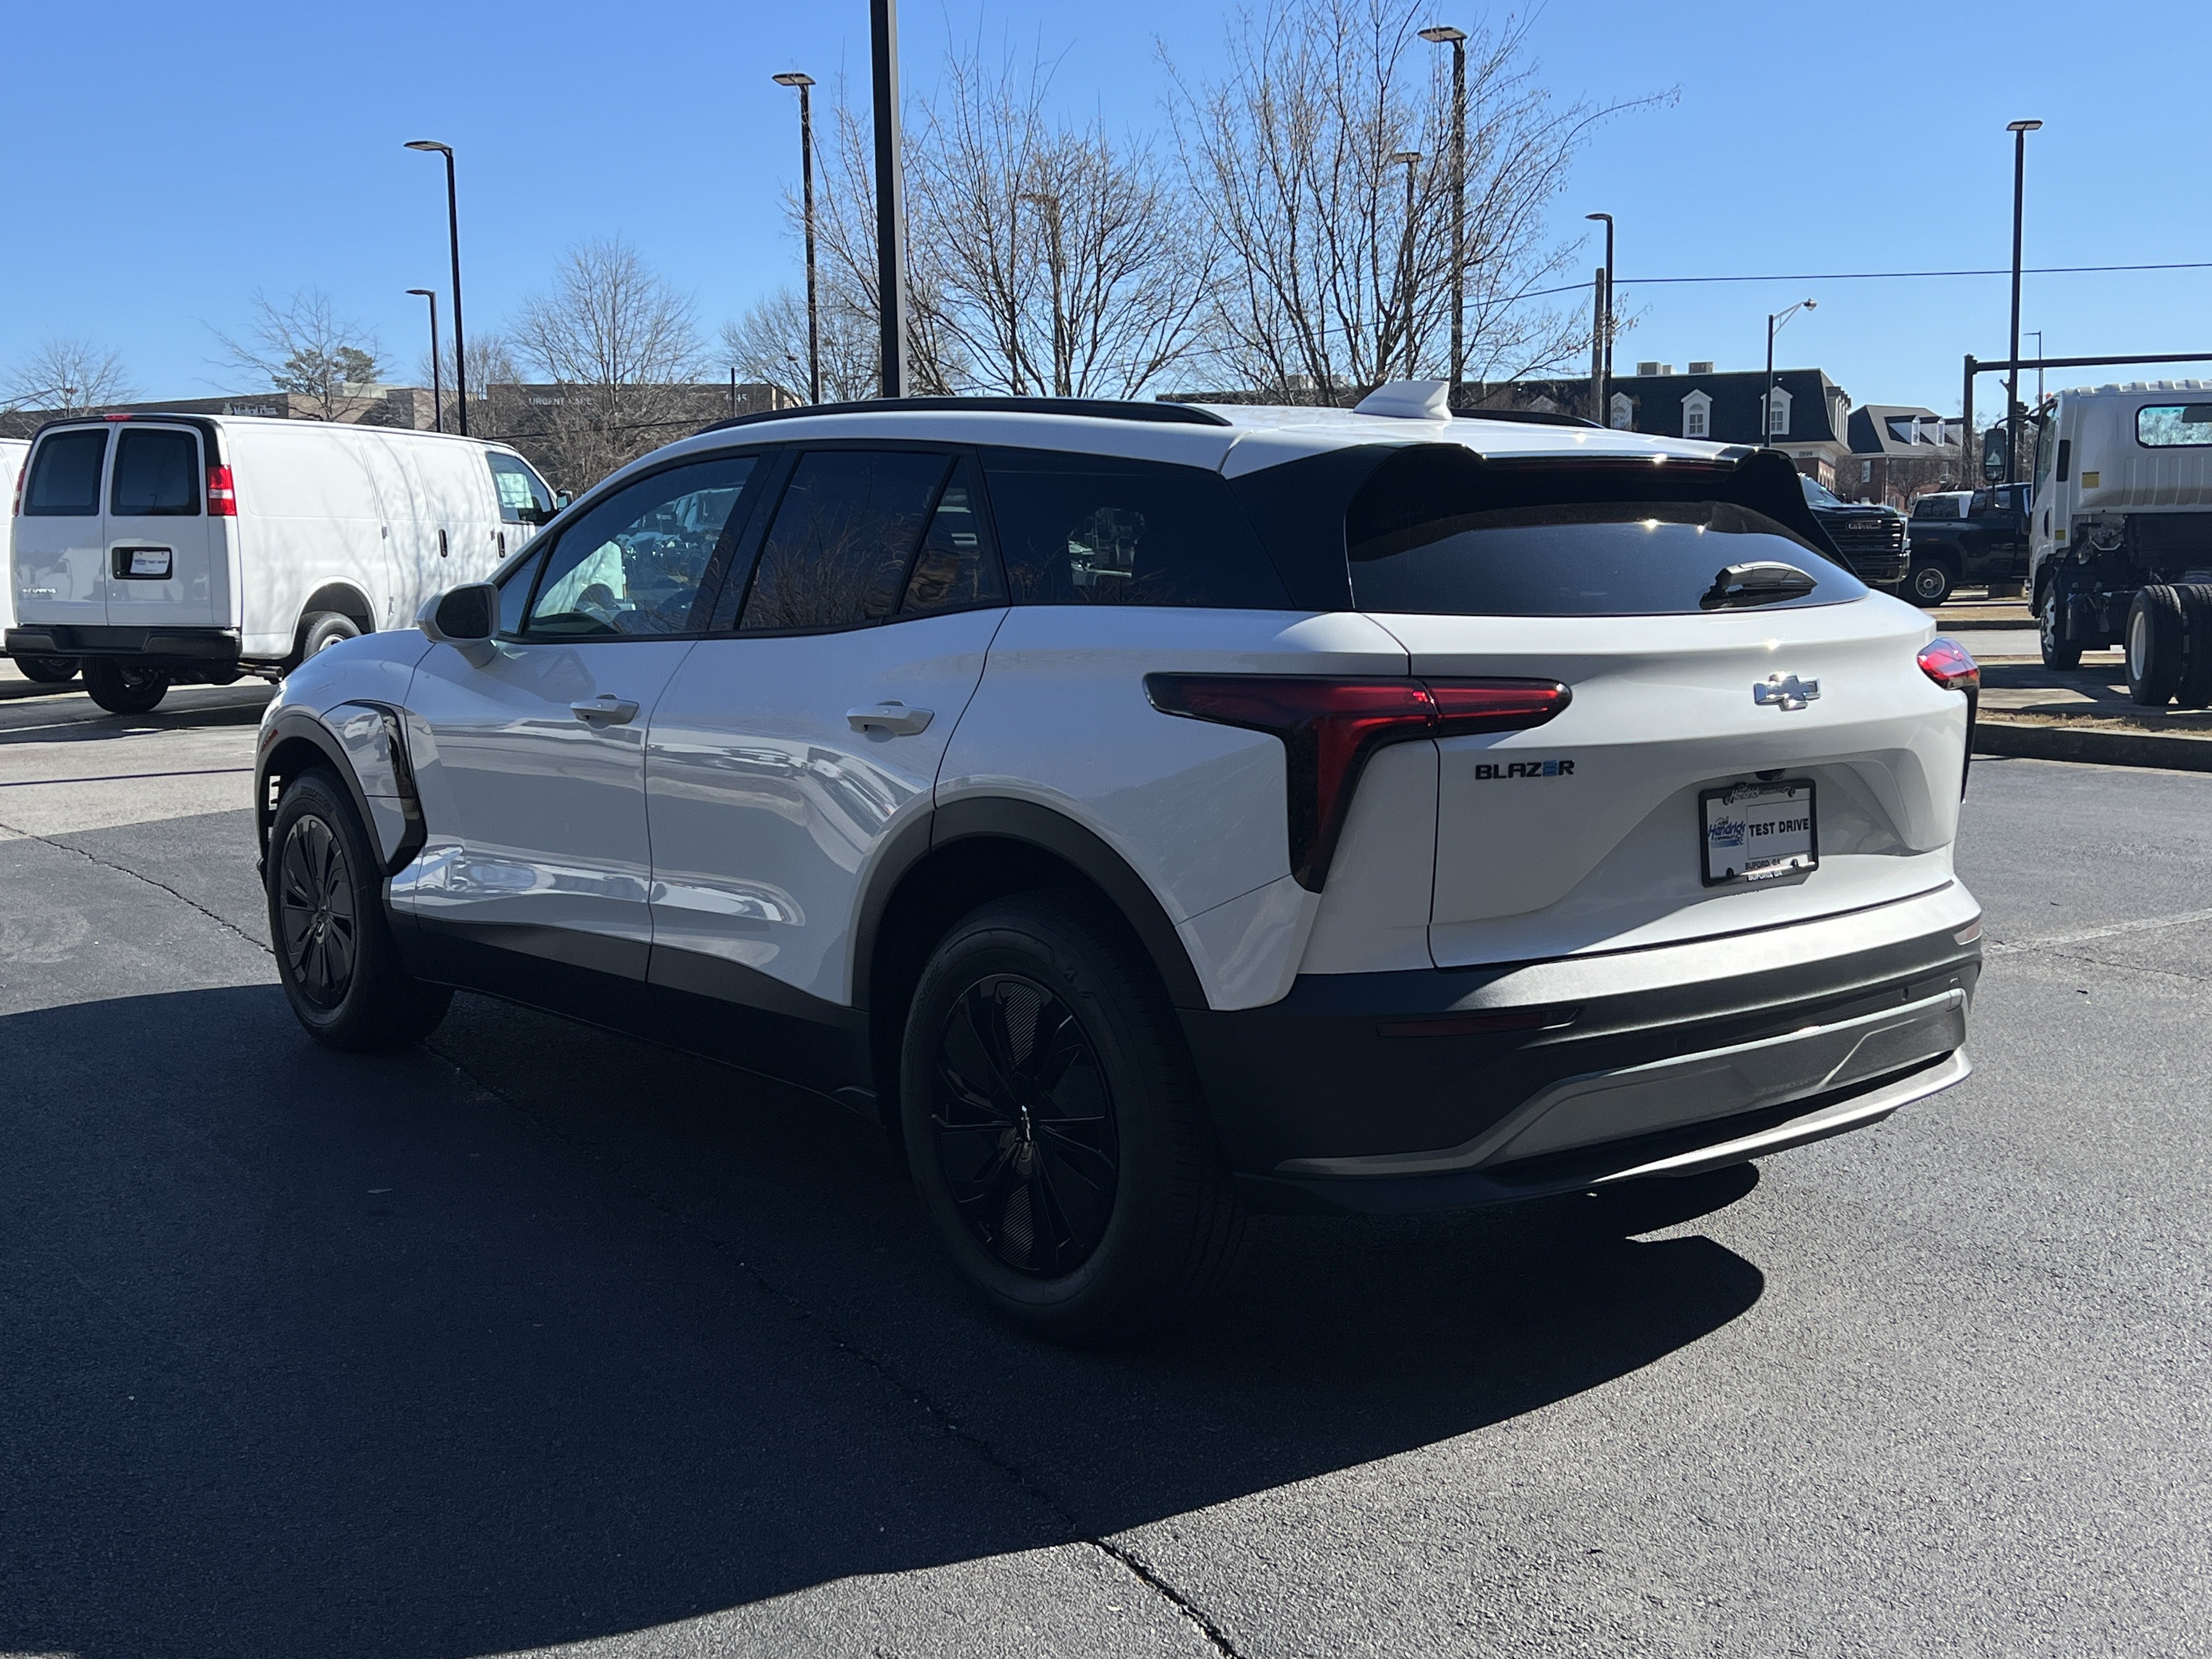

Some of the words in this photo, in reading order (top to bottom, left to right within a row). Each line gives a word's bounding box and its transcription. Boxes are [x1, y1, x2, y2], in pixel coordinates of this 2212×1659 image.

[528, 397, 565, 405] URGENT
[1475, 760, 1575, 780] BLAZER
[1749, 822, 1775, 837] TEST
[1779, 818, 1809, 833] DRIVE
